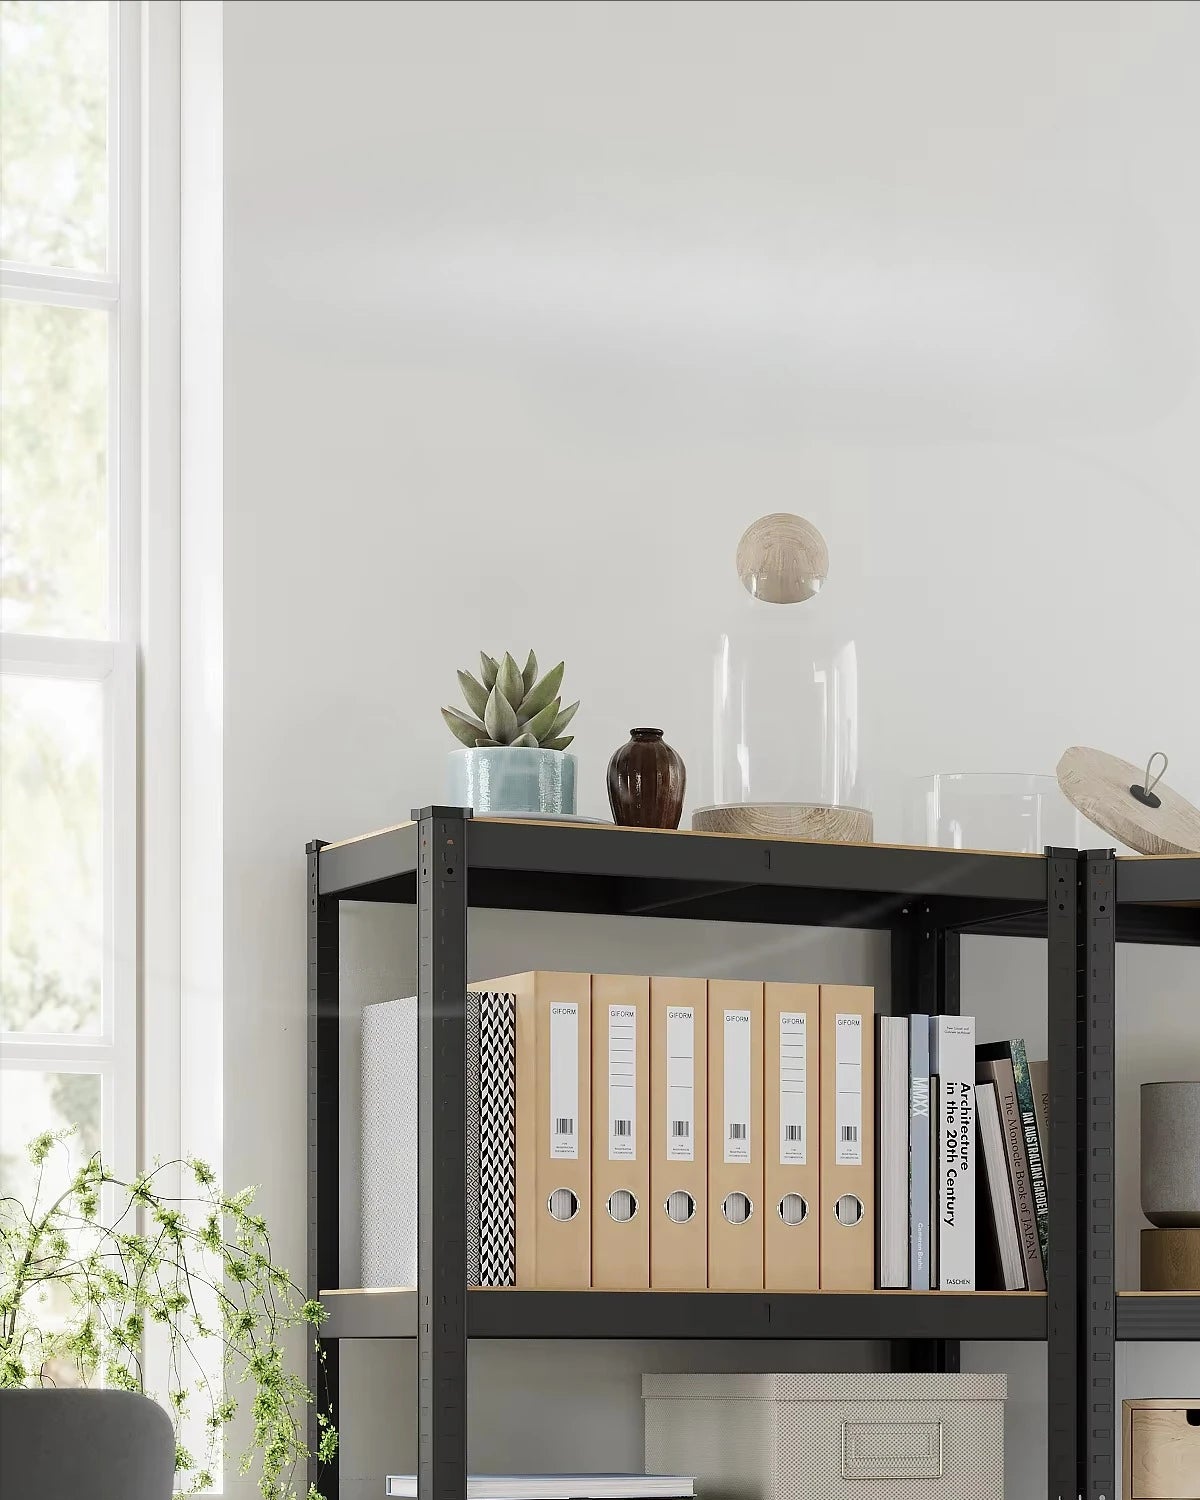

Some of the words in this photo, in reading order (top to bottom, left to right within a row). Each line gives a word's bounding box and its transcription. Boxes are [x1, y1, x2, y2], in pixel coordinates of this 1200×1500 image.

[912, 1077, 929, 1117] MMXX
[946, 1082, 958, 1095] in
[1004, 1091, 1015, 1116] The
[946, 1101, 958, 1124] the
[960, 1082, 972, 1171] Architecture
[1022, 1111, 1035, 1125] AN
[946, 1129, 958, 1163] 20th
[1008, 1119, 1023, 1167] Monocle
[1024, 1125, 1043, 1180] AUSTRALIAN
[943, 1168, 958, 1227] Century
[1016, 1170, 1028, 1200] Book
[1033, 1180, 1048, 1215] GARDEN
[1020, 1202, 1031, 1217] of
[1020, 1218, 1038, 1260] JAPAN
